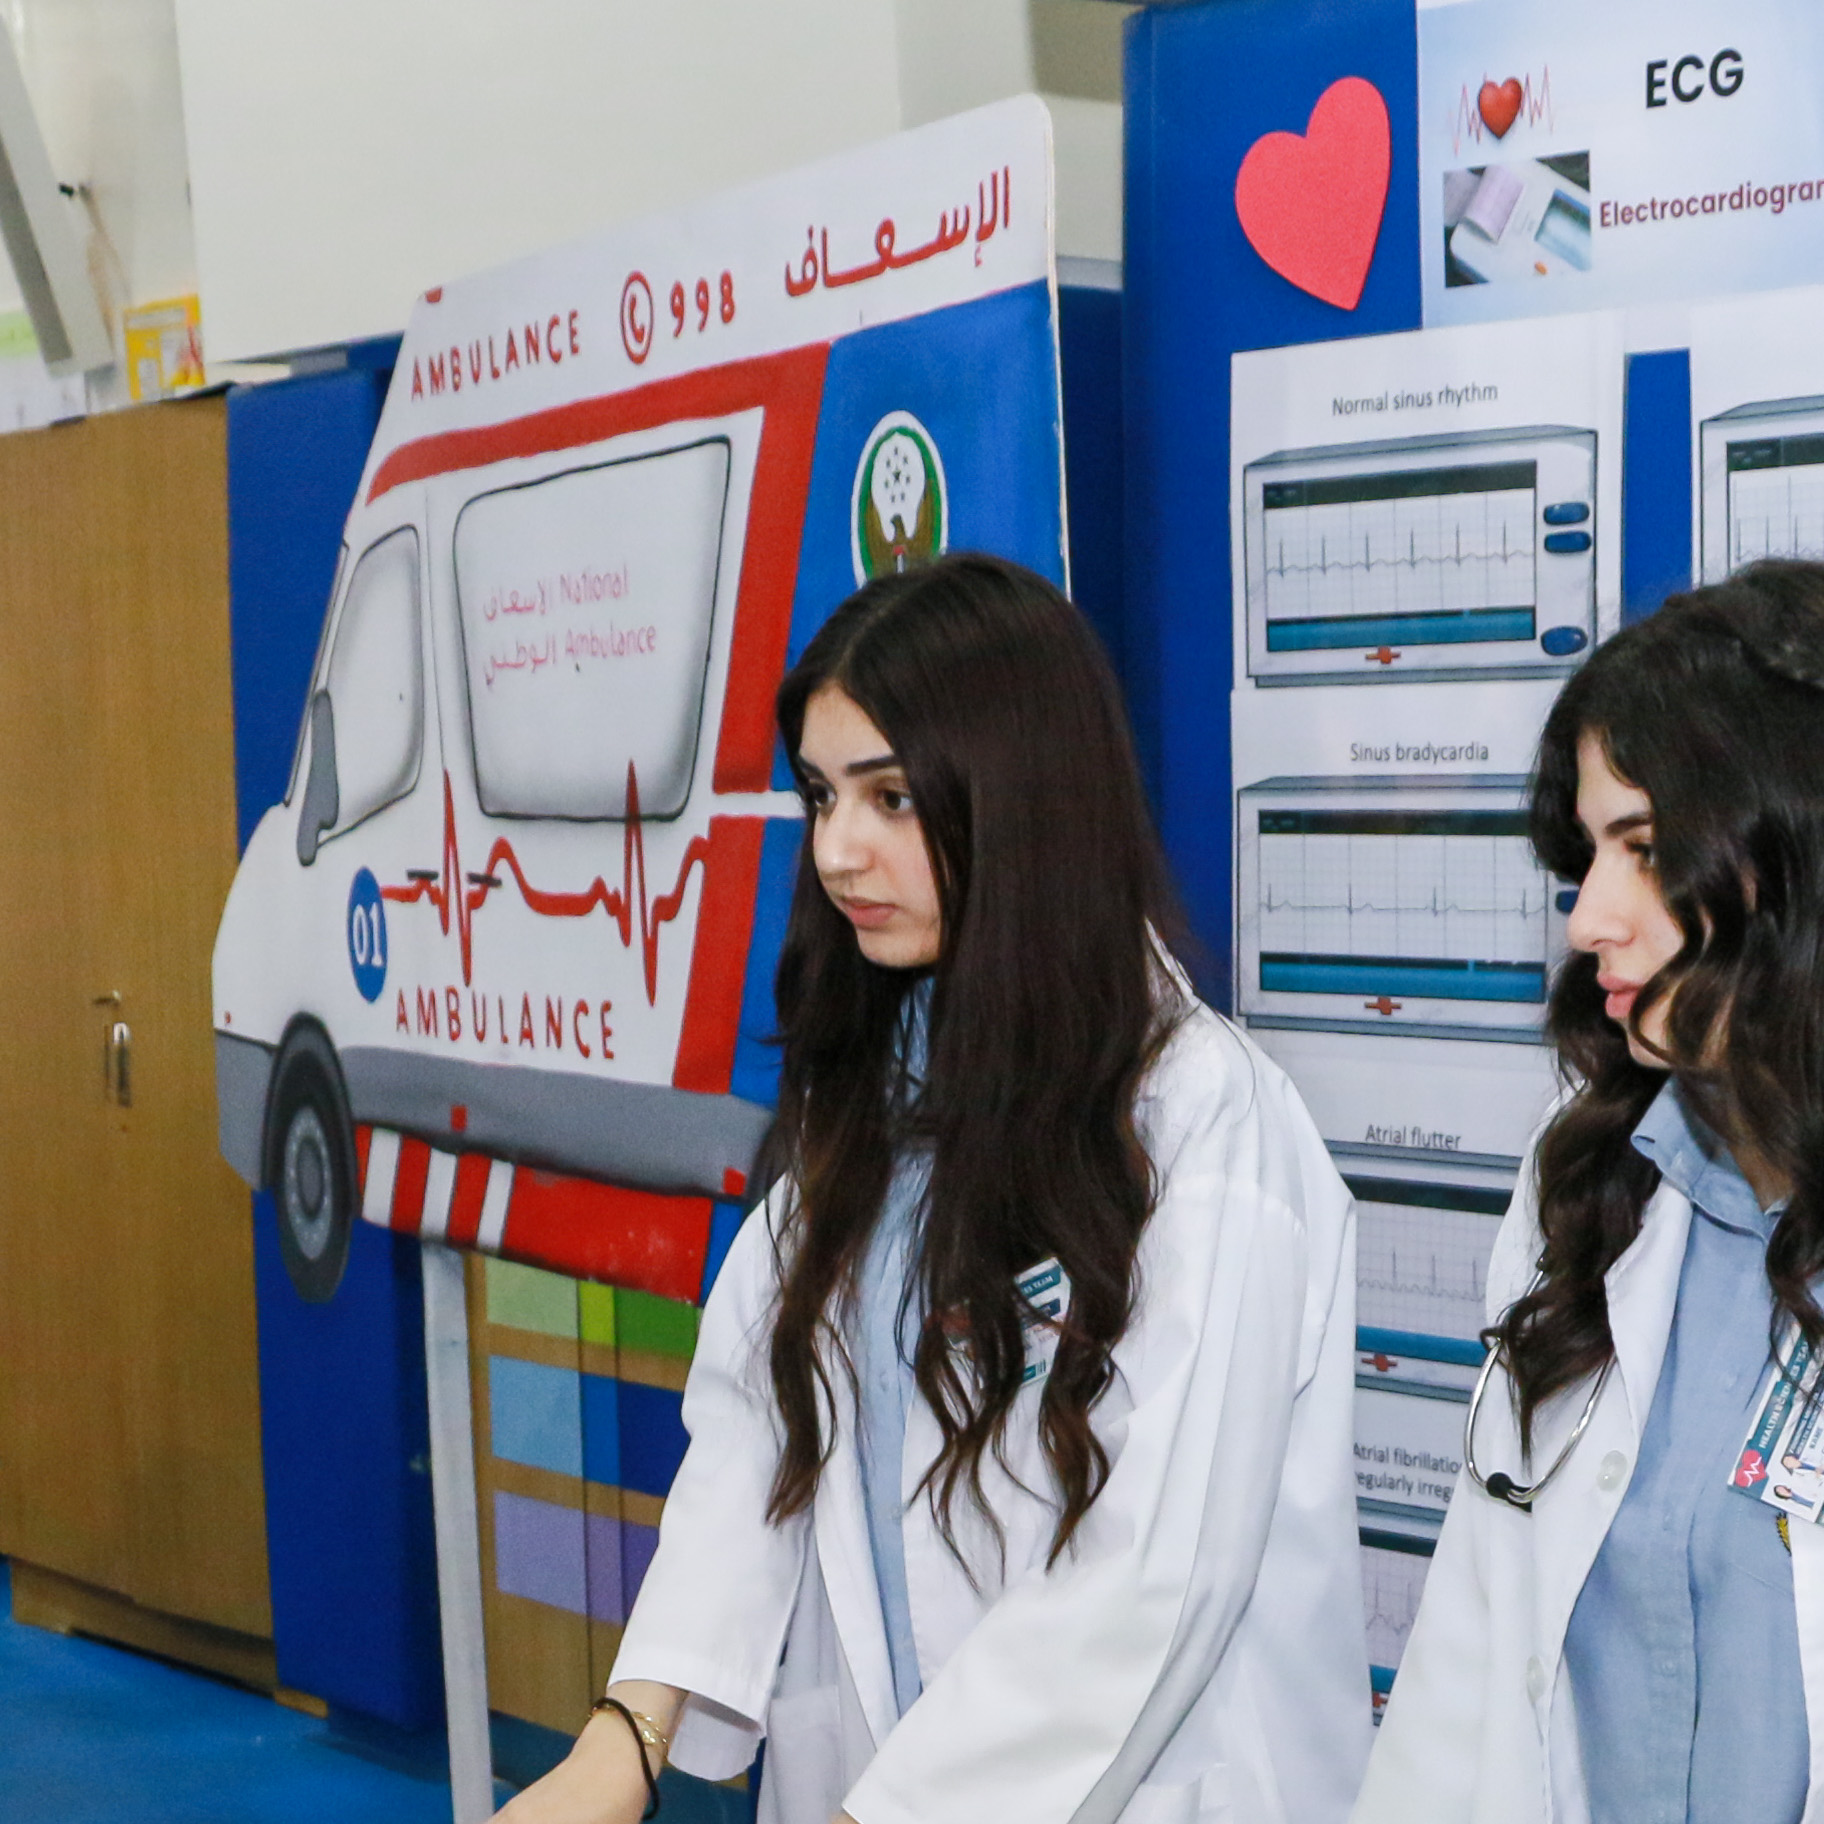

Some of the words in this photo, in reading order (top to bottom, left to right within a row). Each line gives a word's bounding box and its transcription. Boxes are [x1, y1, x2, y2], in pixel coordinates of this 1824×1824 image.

[1646, 49, 1744, 108] ECG
[785, 166, 1011, 298] الإسعاف
[411, 310, 581, 401] AMBULANCE
[670, 272, 736, 338] 998
[1332, 392, 1388, 416] Normal
[1394, 390, 1433, 410] sinus
[1438, 382, 1498, 408] rhythm
[561, 562, 629, 604] National
[565, 620, 656, 660] Ambulance
[1351, 744, 1390, 762] Sinus
[1396, 742, 1488, 764] bradycardia
[354, 903, 385, 968] 01
[396, 986, 615, 1060] AMBULANCE
[1365, 1124, 1406, 1144] Atrial
[1411, 1126, 1461, 1149] flutter
[1353, 1442, 1389, 1463] Atrial
[1394, 1448, 1466, 1474] fibrillatio
